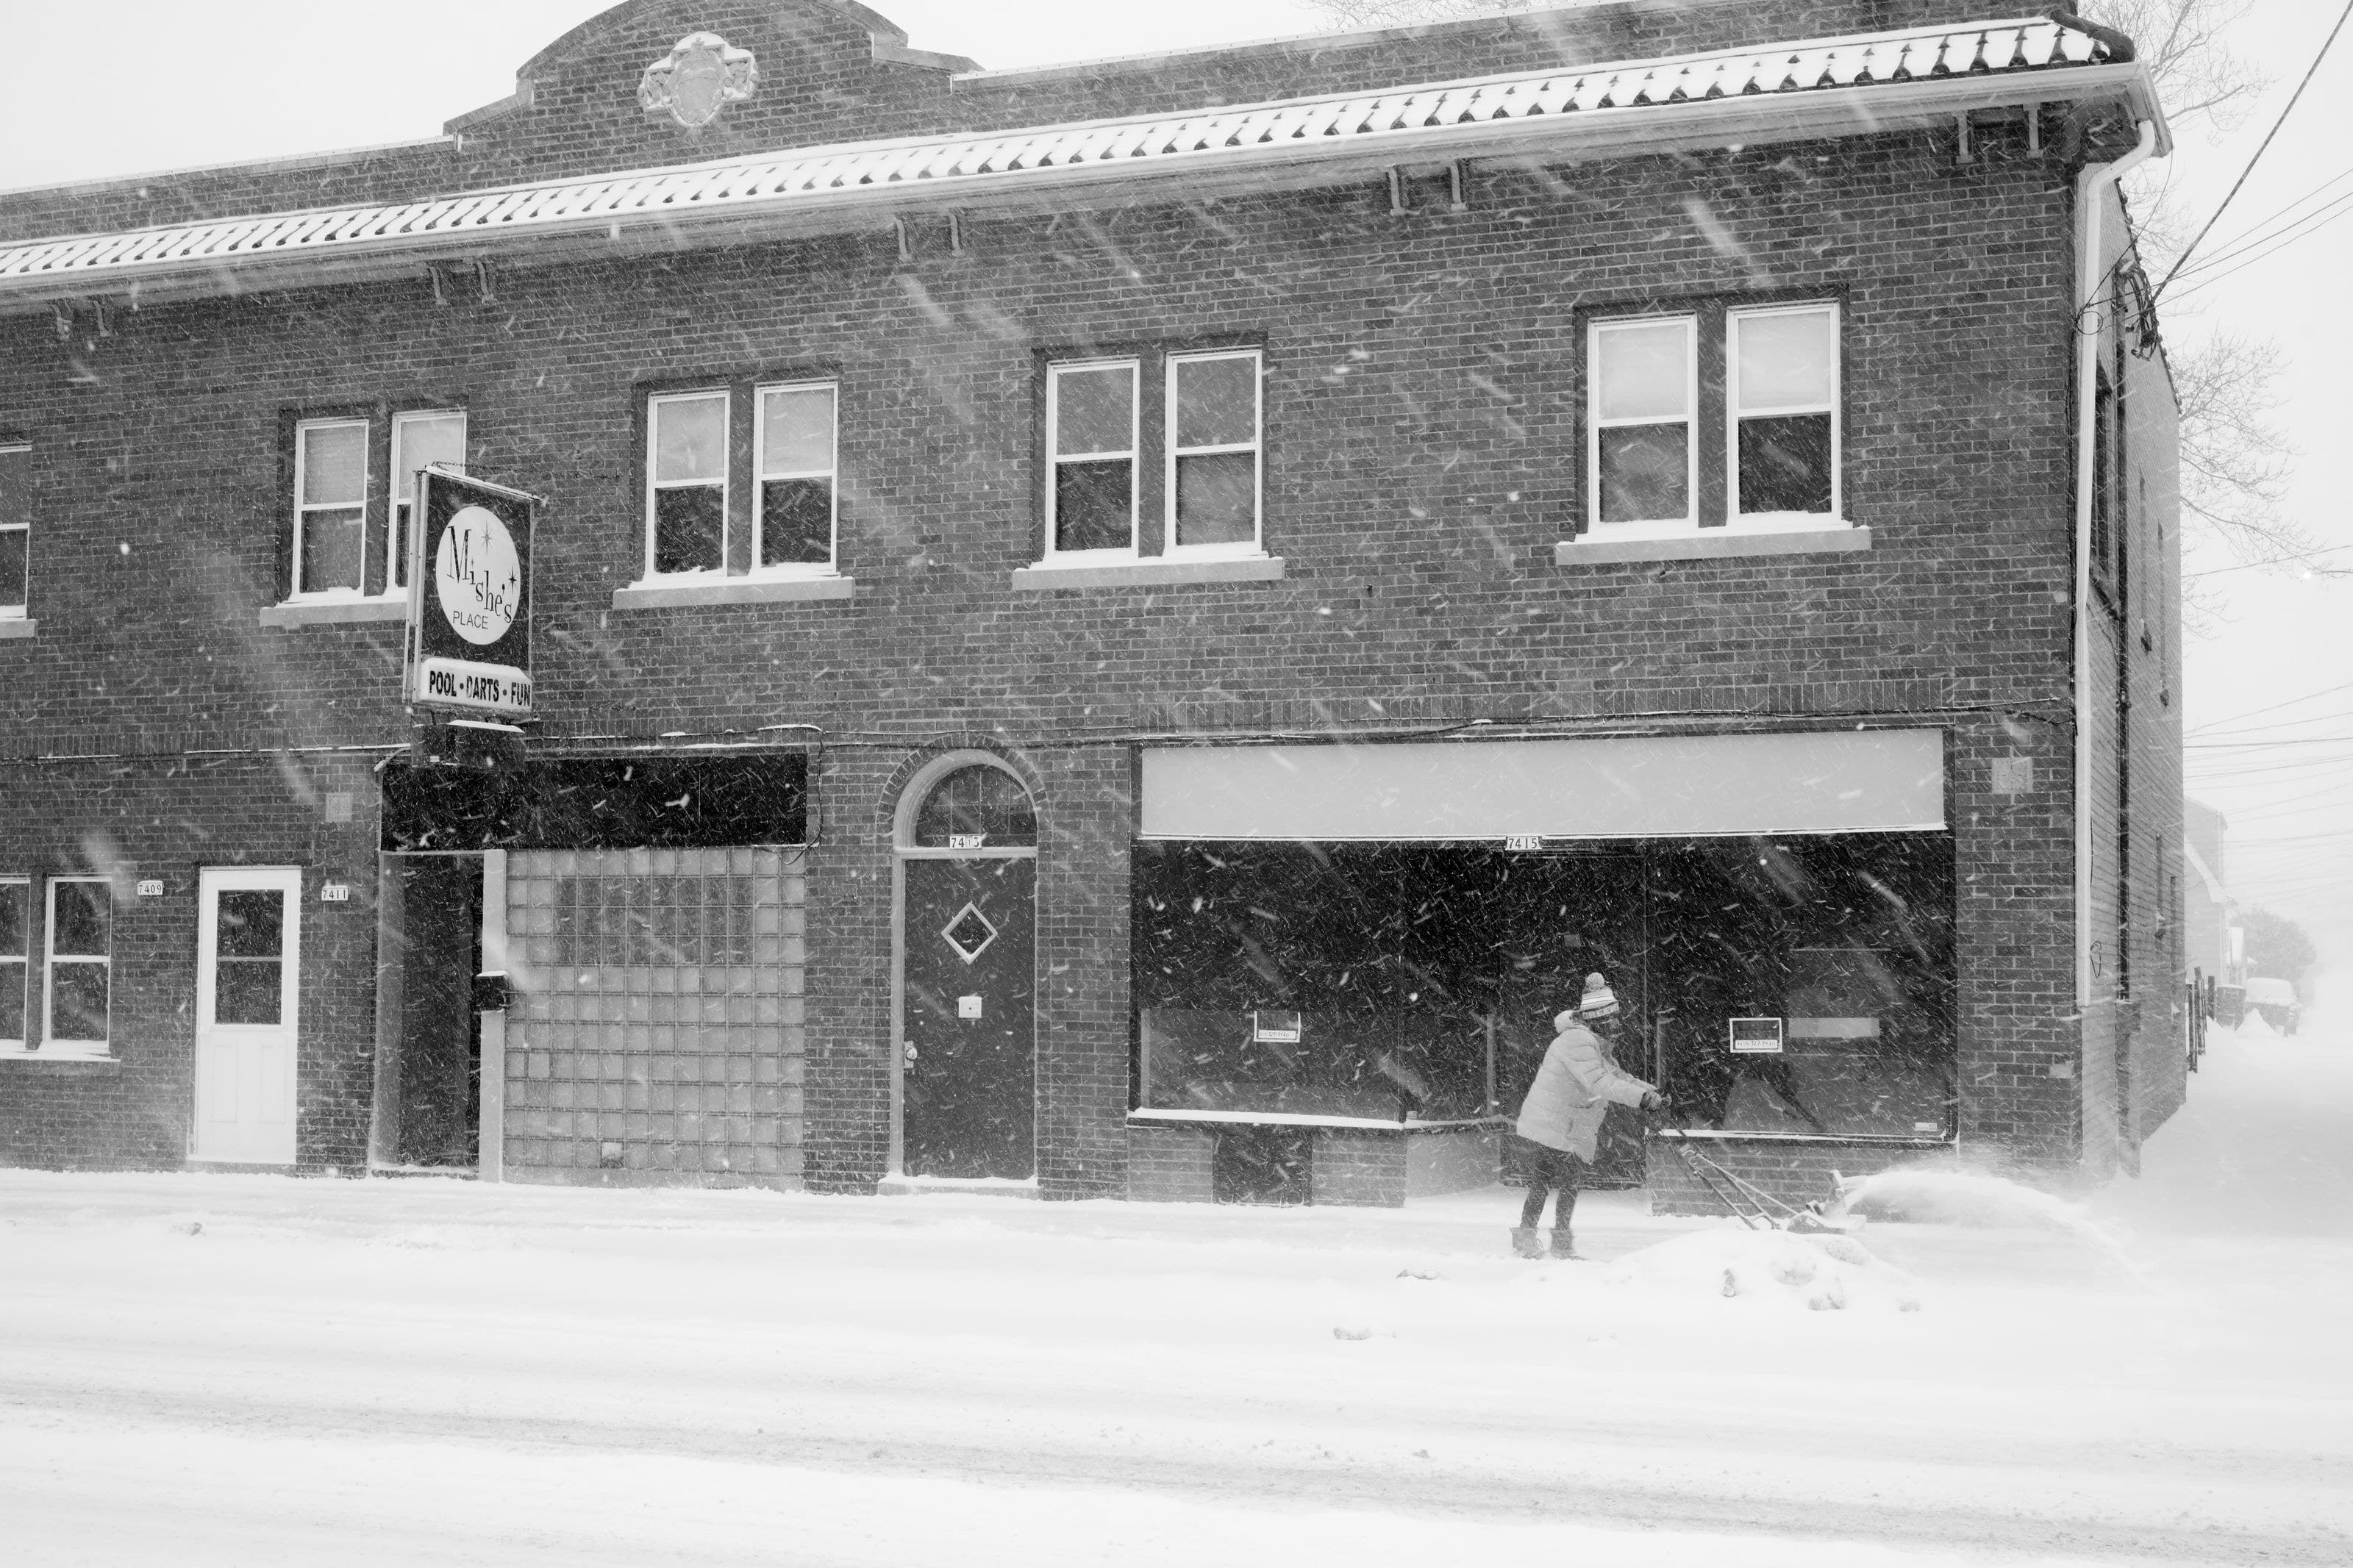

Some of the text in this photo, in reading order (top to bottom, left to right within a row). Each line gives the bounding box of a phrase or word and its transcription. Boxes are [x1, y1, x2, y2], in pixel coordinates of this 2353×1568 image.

[447, 526, 513, 623] Mishe's
[453, 611, 488, 629] PLACE
[429, 670, 530, 706] POOL DARTS FUN
[1508, 838, 1538, 849] 7415
[138, 884, 162, 893] 7409
[323, 889, 346, 899] 7411
